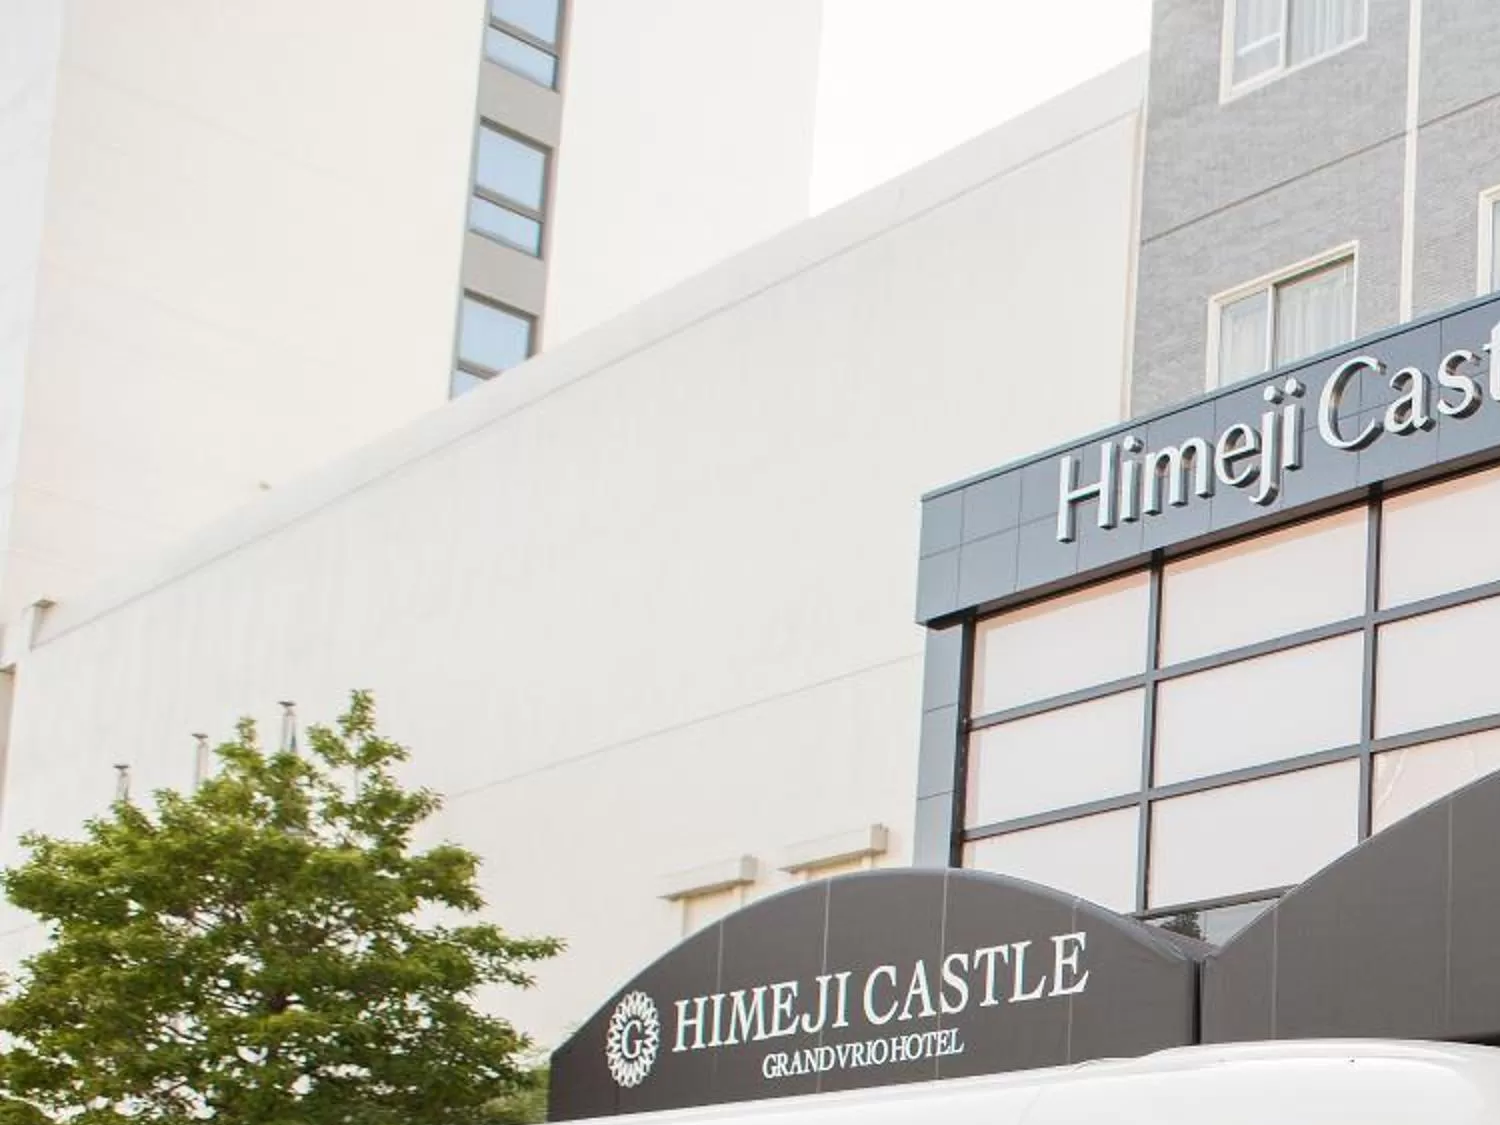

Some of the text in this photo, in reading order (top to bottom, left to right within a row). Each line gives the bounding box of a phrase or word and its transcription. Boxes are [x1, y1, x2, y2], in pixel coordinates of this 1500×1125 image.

[1057, 380, 1306, 542] Himeji
[672, 931, 1090, 1052] HIMEJI CASTLE
[888, 1028, 965, 1063] HOTEL
